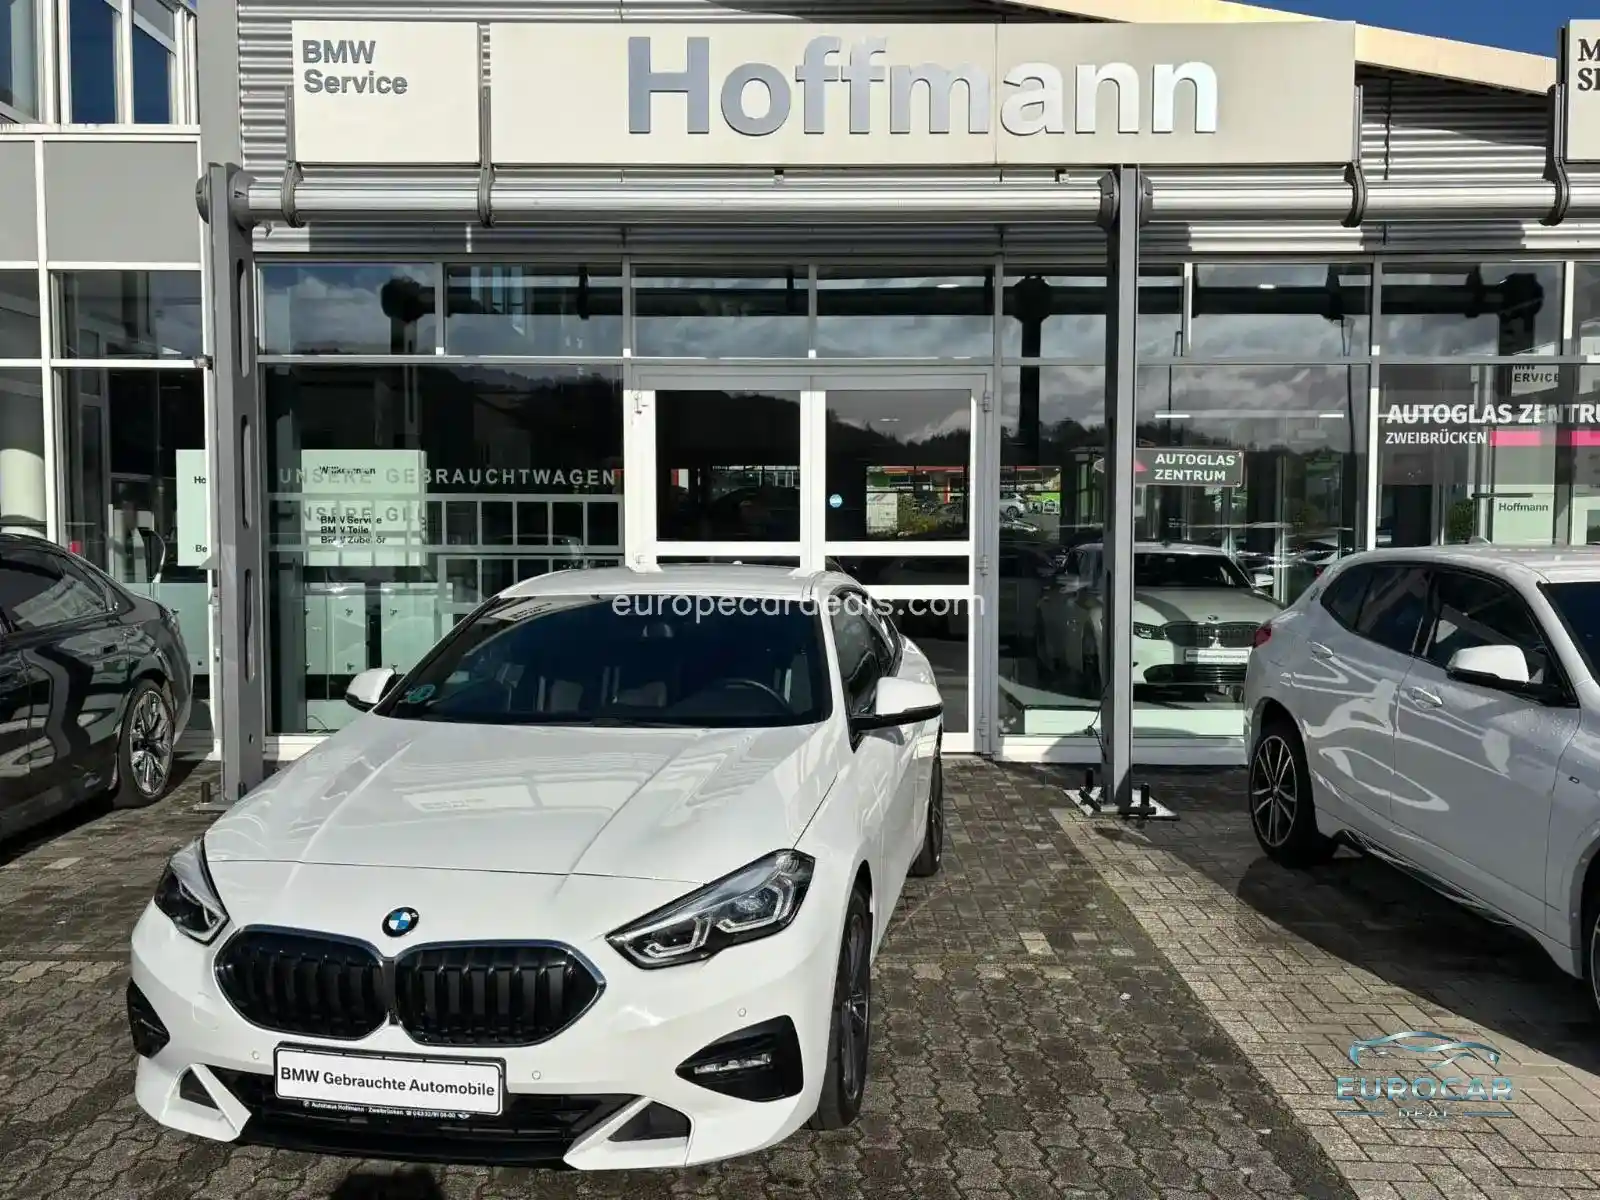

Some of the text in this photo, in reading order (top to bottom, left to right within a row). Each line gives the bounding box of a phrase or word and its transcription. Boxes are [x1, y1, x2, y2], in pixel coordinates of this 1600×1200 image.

[302, 39, 376, 64] BMW
[303, 68, 408, 94] Service
[627, 36, 1219, 136] Hoffmann
[1386, 404, 1512, 424] AUTOGLAS
[1385, 429, 1486, 445] ZWEIBRÜCKEN
[1155, 453, 1236, 466] AUTOGLAS
[385, 468, 616, 485] GEBRAUCHTWAGEN
[1154, 469, 1226, 481] ZENTRUM
[1498, 502, 1549, 512] Hoffmann
[347, 515, 382, 524] Servie
[281, 1066, 495, 1097] BMW Gebrauchte Automobile
